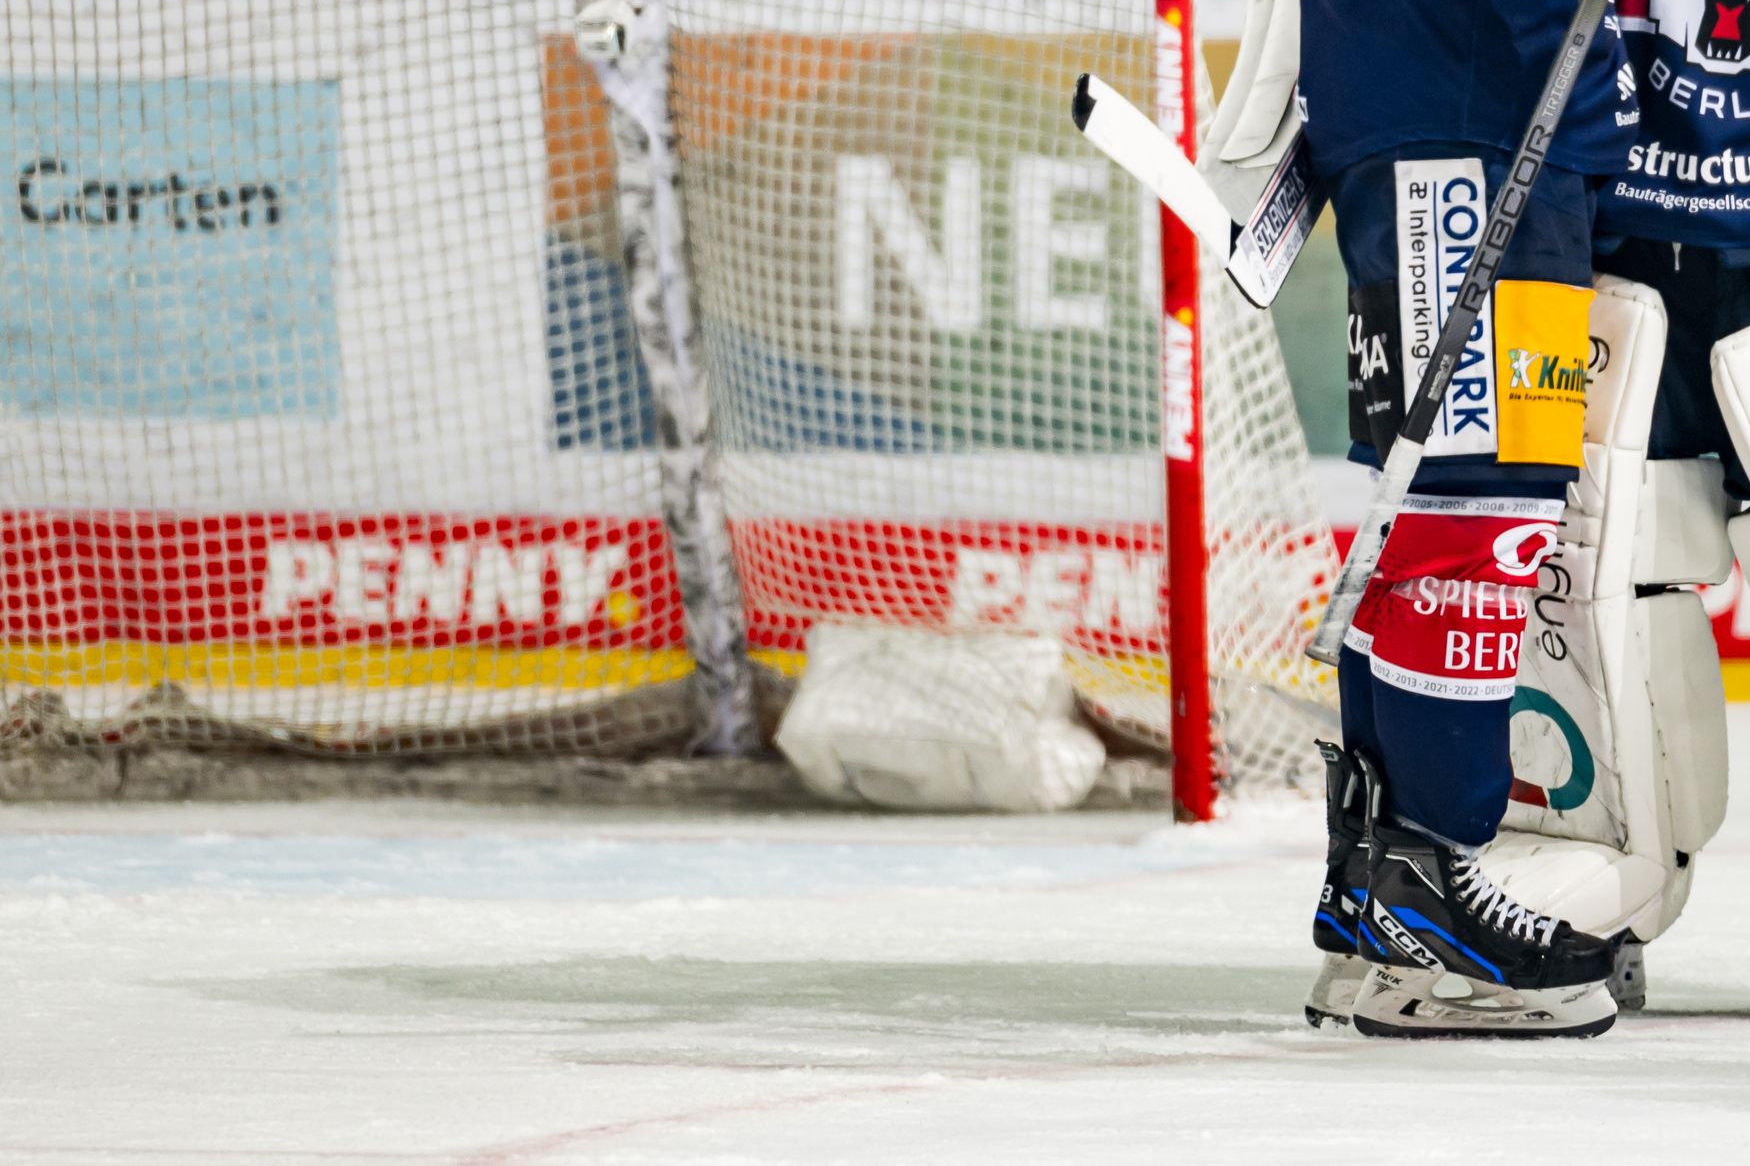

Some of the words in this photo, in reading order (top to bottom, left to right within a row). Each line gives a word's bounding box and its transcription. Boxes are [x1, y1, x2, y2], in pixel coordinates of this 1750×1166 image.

[1157, 6, 1184, 136] ENNY.
[1542, 46, 1580, 118] TRIGGER
[836, 154, 1162, 333] NE
[1460, 122, 1553, 315] RIBCOR
[1164, 307, 1194, 462] PENNY.
[1438, 500, 1468, 510] 2006
[1475, 502, 1505, 512] 2008
[1512, 502, 1540, 513] 2009
[260, 536, 640, 629] PENNY.
[949, 547, 1168, 633] PEN
[1413, 575, 1528, 621] SPIELB
[1373, 661, 1391, 678] 2012
[1395, 673, 1418, 688] 2013
[1424, 681, 1448, 693] 2021
[1454, 685, 1479, 696] 2022
[1484, 685, 1514, 696] DEUTS
[1443, 629, 1525, 672] BER
[1378, 914, 1440, 968] CCM
